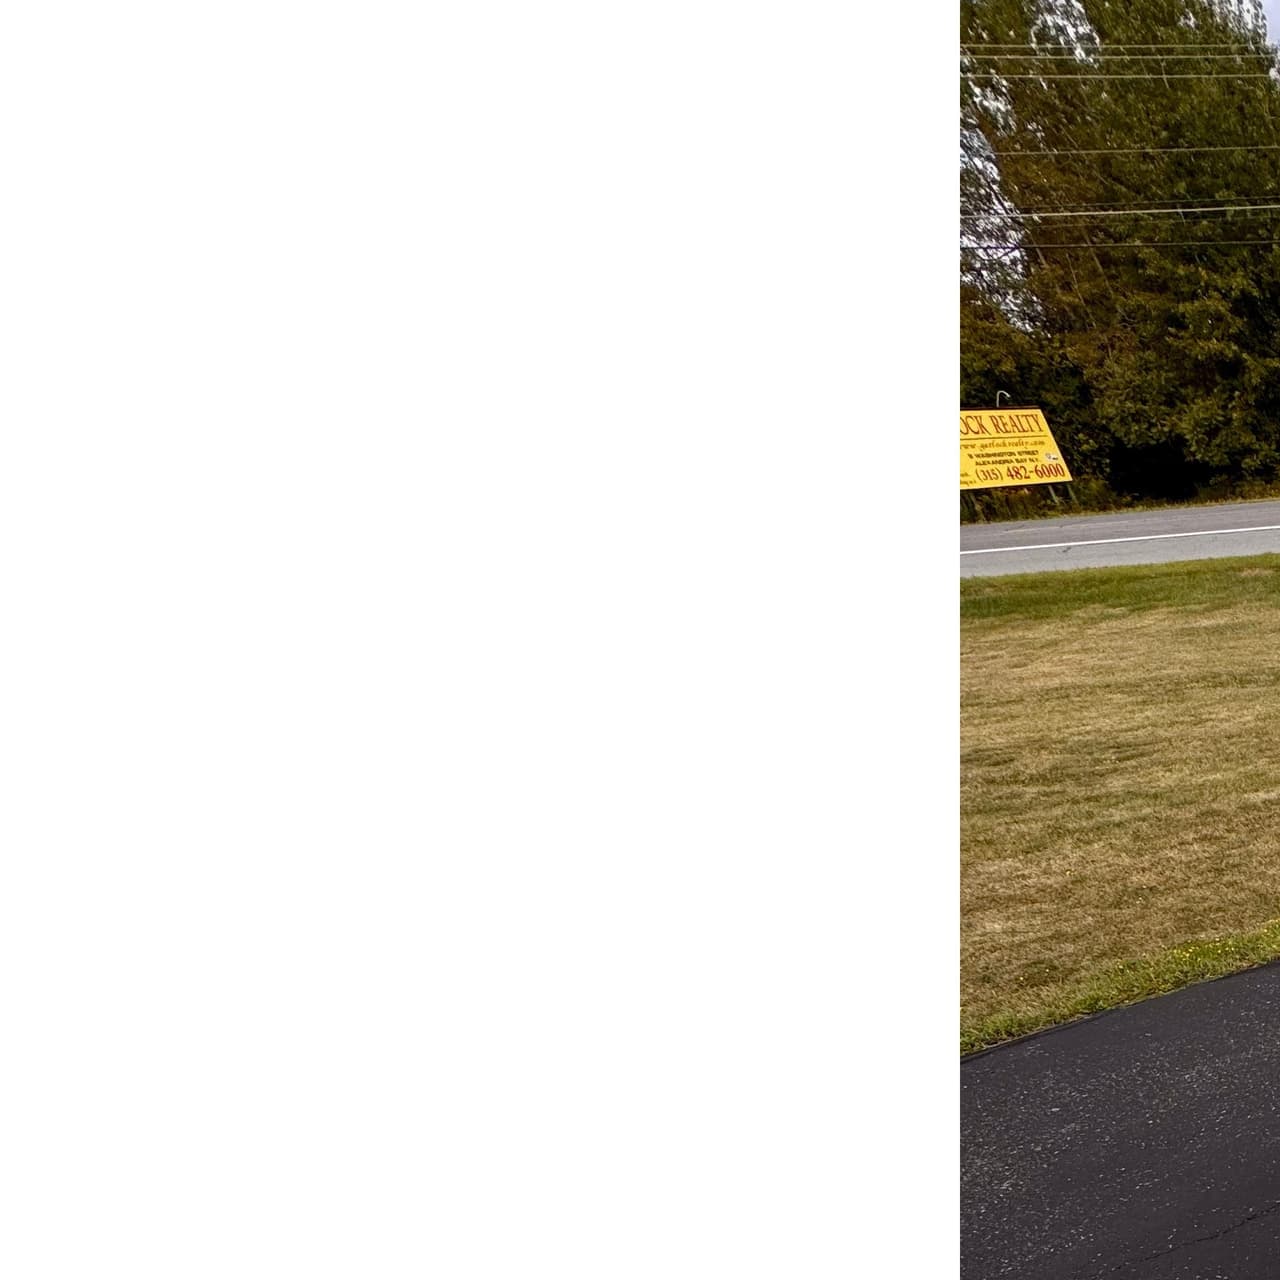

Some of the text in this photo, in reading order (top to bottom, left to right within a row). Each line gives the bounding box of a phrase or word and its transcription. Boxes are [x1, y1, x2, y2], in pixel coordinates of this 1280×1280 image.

[990, 414, 1043, 434] REALTY
[975, 463, 1065, 481] (315) 482-6000
